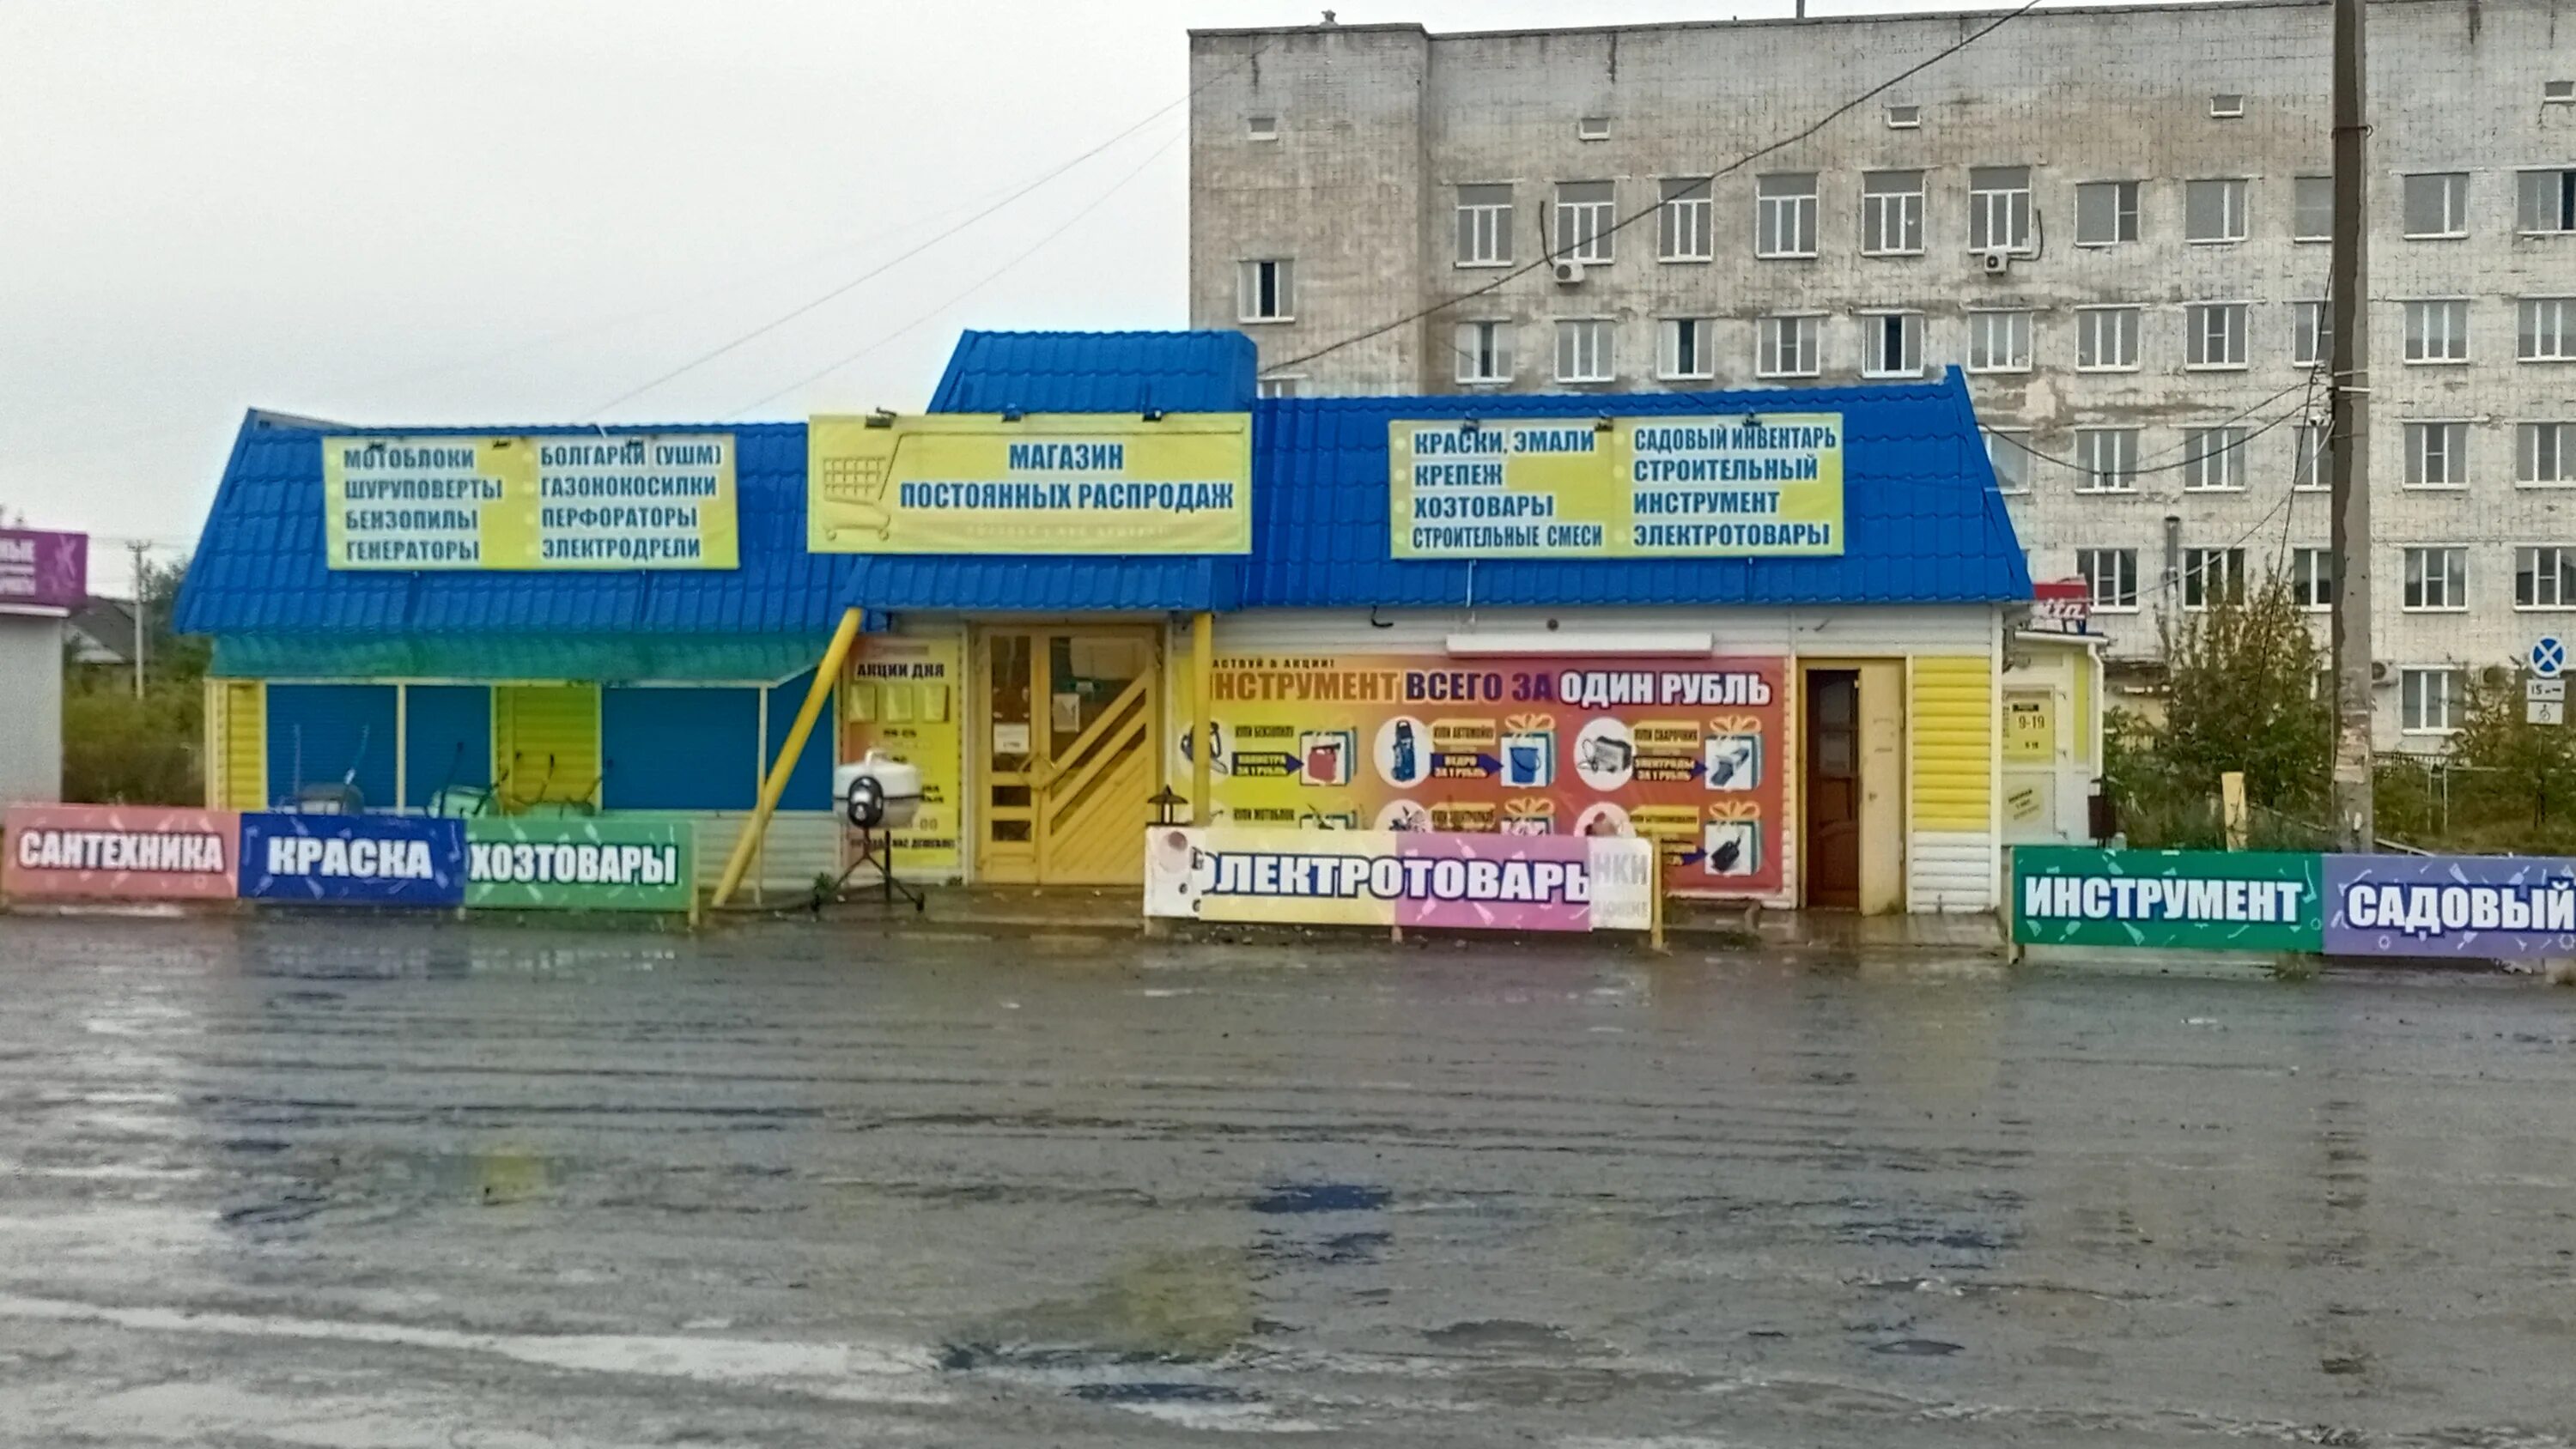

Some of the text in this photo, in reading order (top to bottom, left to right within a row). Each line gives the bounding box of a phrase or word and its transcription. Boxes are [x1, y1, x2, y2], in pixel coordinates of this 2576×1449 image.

[1514, 430, 1595, 452] ЭМАЛИ
[1634, 425, 1836, 454] САДОВЫЙ ИНВЕНТАРЬ
[343, 446, 475, 470] МОТОБЛОКИ
[540, 445, 646, 466] БОЛГАРКИ
[1009, 444, 1124, 470] МАГАЗИН
[1414, 464, 1503, 487] КРЕПЕЖ
[1633, 454, 1818, 482] СТРОИТЕЛЬНЫЙ
[344, 479, 503, 501] ШУРУПОВЕРТЫ
[541, 476, 717, 498] ГАЗОНОКОСИЛКИ
[900, 482, 1234, 514] ПОСТОЯННЫХ РАСПРОДАЖ
[1414, 495, 1553, 518] ХОЗТОВАРЫ
[1633, 491, 1780, 515] ИНСТРУМЕНТ
[345, 509, 477, 531] БЕНЗОПИЛЫ
[542, 506, 697, 530] ПЕРФОРАТОРЫ
[1413, 524, 1602, 549] СТРОИТЕЛЬНЫЕ СМЕСИ
[1633, 523, 1830, 549] ЭЛЕКТРОТОВАРЫ
[346, 539, 479, 562] ГЕНЕРАТОРЫ
[542, 538, 702, 561] ЭЛЕКТРОДРЕЛИ
[857, 663, 945, 680] АКЦИИ ДНЯ
[1212, 658, 1263, 669] АСТВУЙ
[1210, 671, 1771, 708] НСТРУМЕНТ ВСЕГО ЗА ОДИН РУБЛЬ
[19, 829, 226, 872] САНТЕХНИКА
[268, 836, 434, 878] КРАСКА
[470, 843, 678, 884] ХОЗТОВАРЫ
[2025, 876, 2305, 924] ИНСТРУМЕНТ
[2348, 879, 2575, 934] САДОВЫЙ
